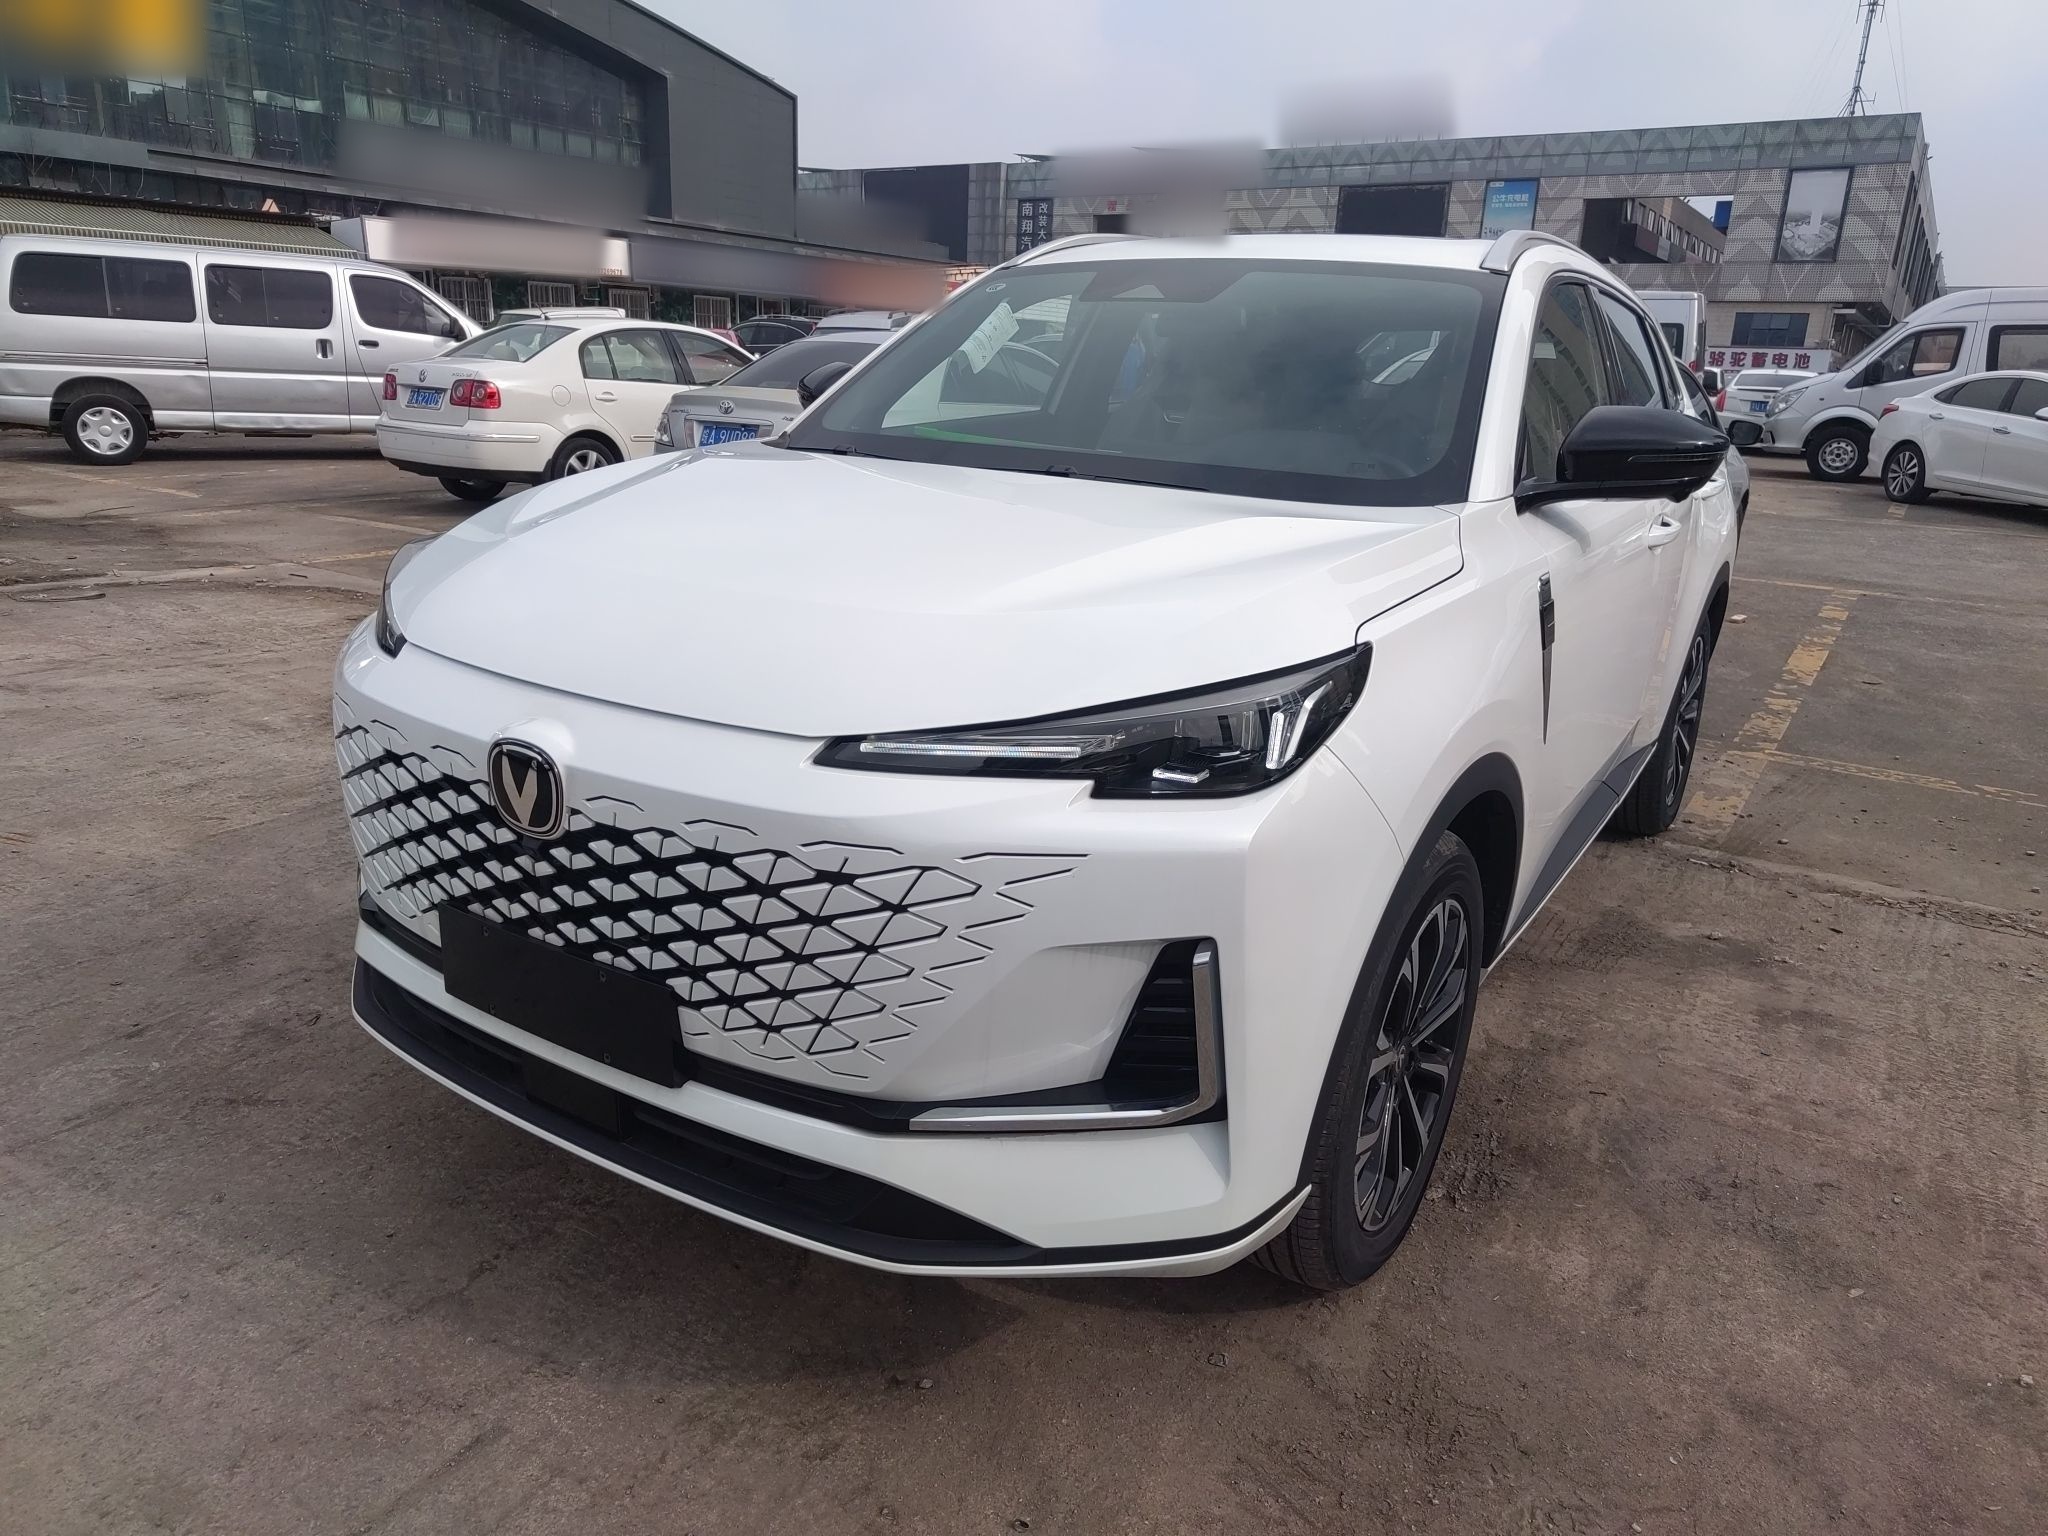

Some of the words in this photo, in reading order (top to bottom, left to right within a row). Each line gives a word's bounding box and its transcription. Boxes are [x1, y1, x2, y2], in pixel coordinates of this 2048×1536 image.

[1708, 351, 1811, 369] 骆驼蓄电池
